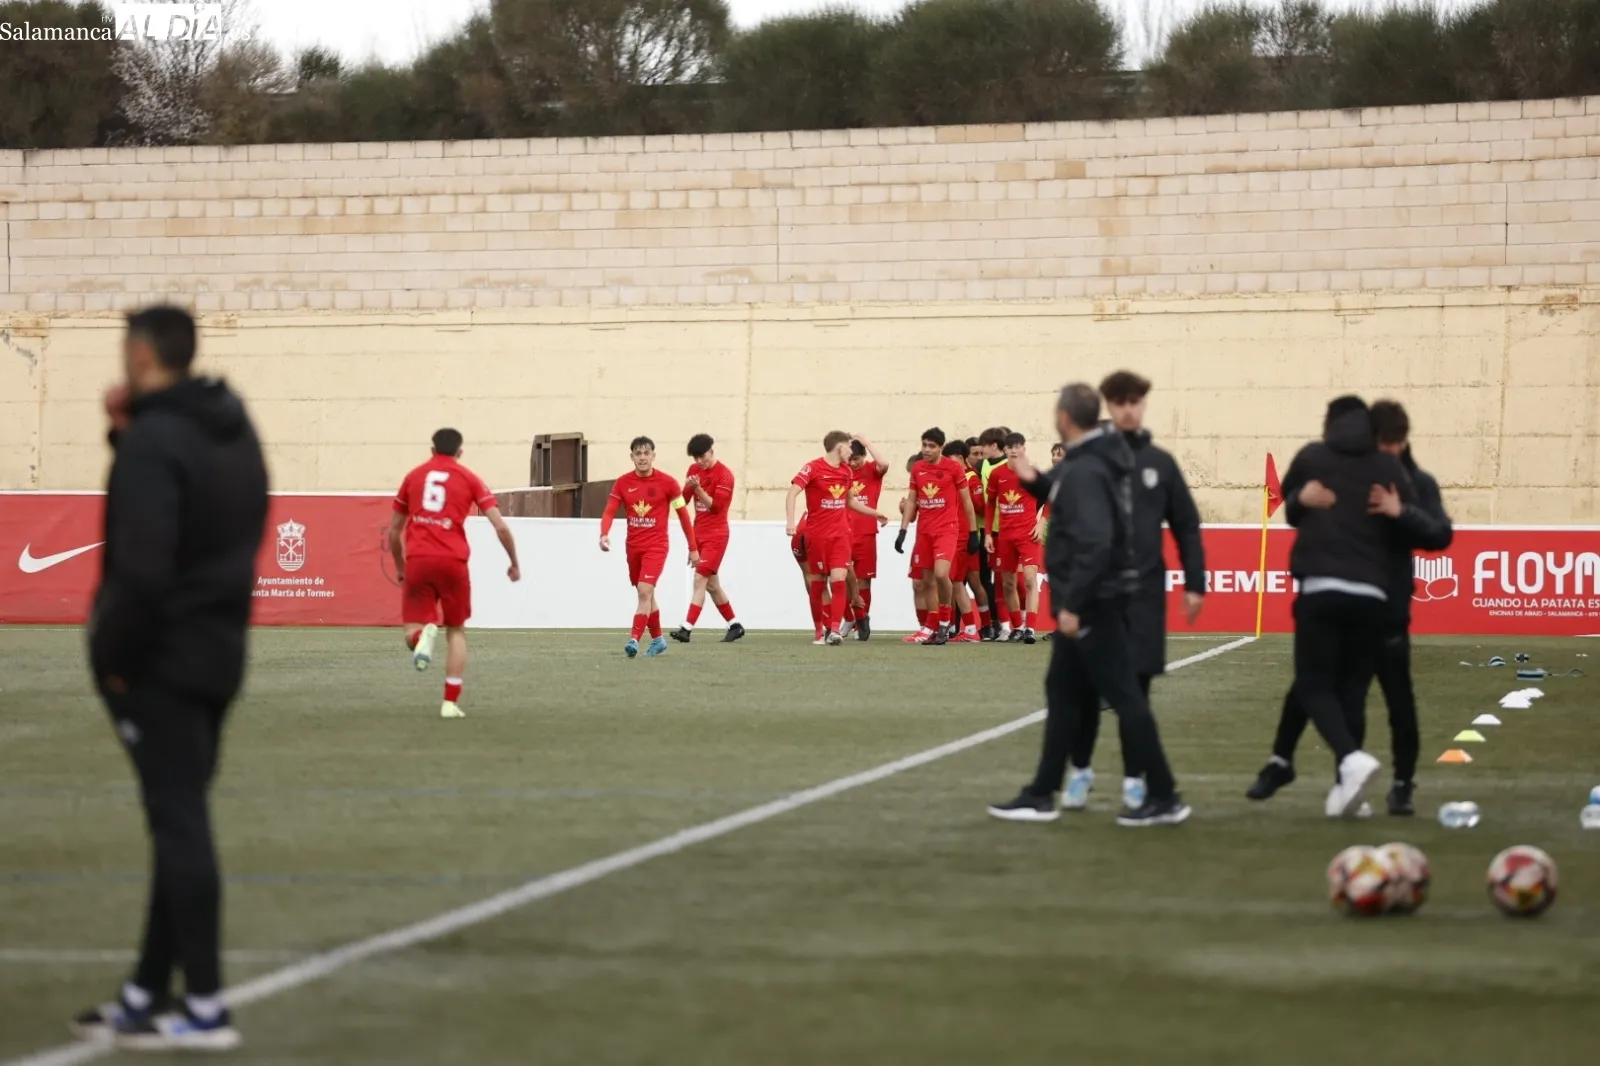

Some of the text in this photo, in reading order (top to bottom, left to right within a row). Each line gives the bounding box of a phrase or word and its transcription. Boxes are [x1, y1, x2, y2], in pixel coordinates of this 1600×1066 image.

[422, 470, 450, 512] 6
[257, 576, 324, 586] Ayuntamiento de
[251, 589, 269, 597] anta
[295, 588, 305, 597] de
[306, 588, 335, 597] Tormes
[1472, 598, 1521, 607] CUANDO
[1524, 598, 1538, 608] LA
[1541, 598, 1585, 608] PATATA
